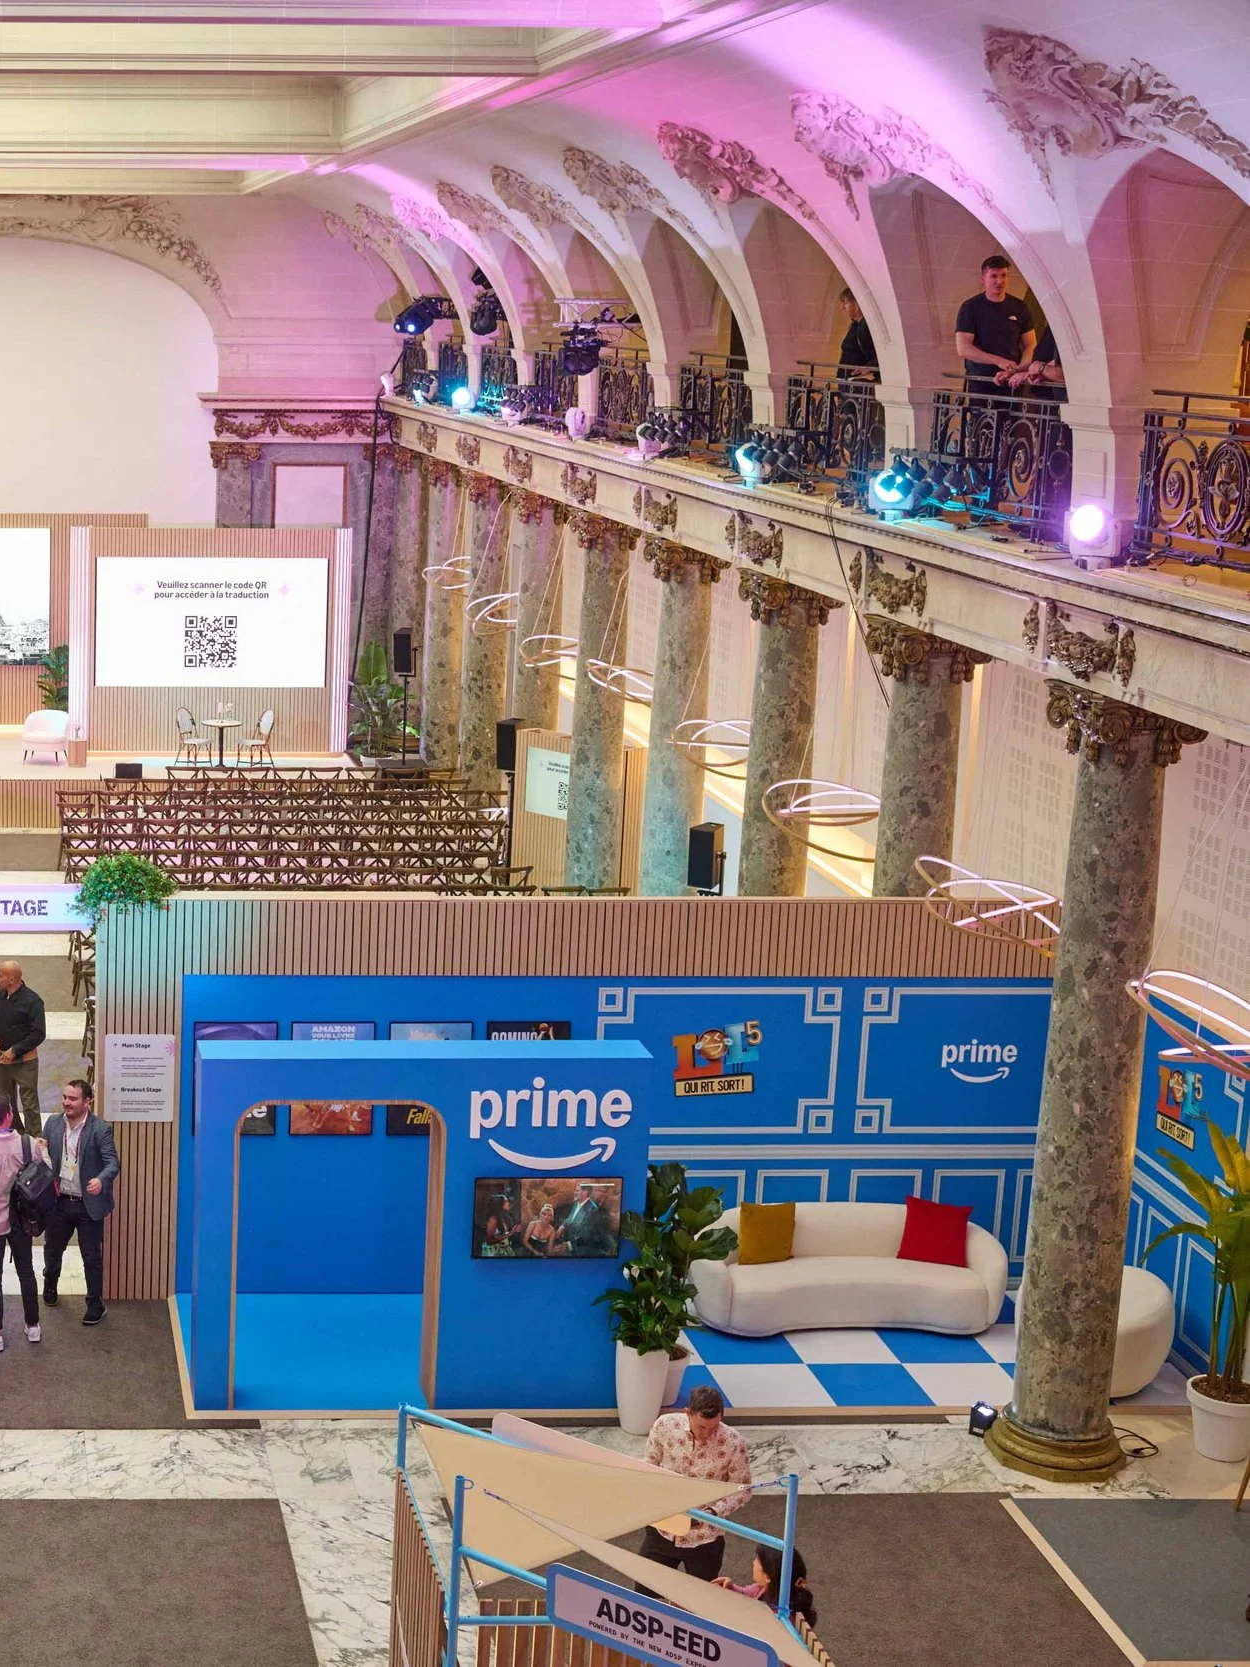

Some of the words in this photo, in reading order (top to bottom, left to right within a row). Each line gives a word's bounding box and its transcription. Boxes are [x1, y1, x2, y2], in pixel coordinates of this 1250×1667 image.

[157, 581, 189, 589] Veuillez
[224, 581, 233, 589] le
[233, 581, 254, 589] code
[254, 581, 267, 590] QR
[154, 592, 174, 600] pour
[175, 590, 209, 599] accéder
[210, 590, 215, 599] à
[216, 590, 224, 599] la
[225, 591, 269, 599] traduction
[311, 1025, 355, 1033] AMAZON
[941, 1038, 1018, 1068] prime
[683, 1081, 699, 1094] QUI
[406, 1108, 431, 1125] Fall
[469, 1077, 633, 1139] prime
[596, 1598, 721, 1663] ADSP-EED
[588, 1620, 617, 1637] POWERED
[620, 1631, 629, 1641] BY
[633, 1637, 645, 1648] THE
[648, 1643, 662, 1654] NEW
[665, 1649, 682, 1661] ADSP
